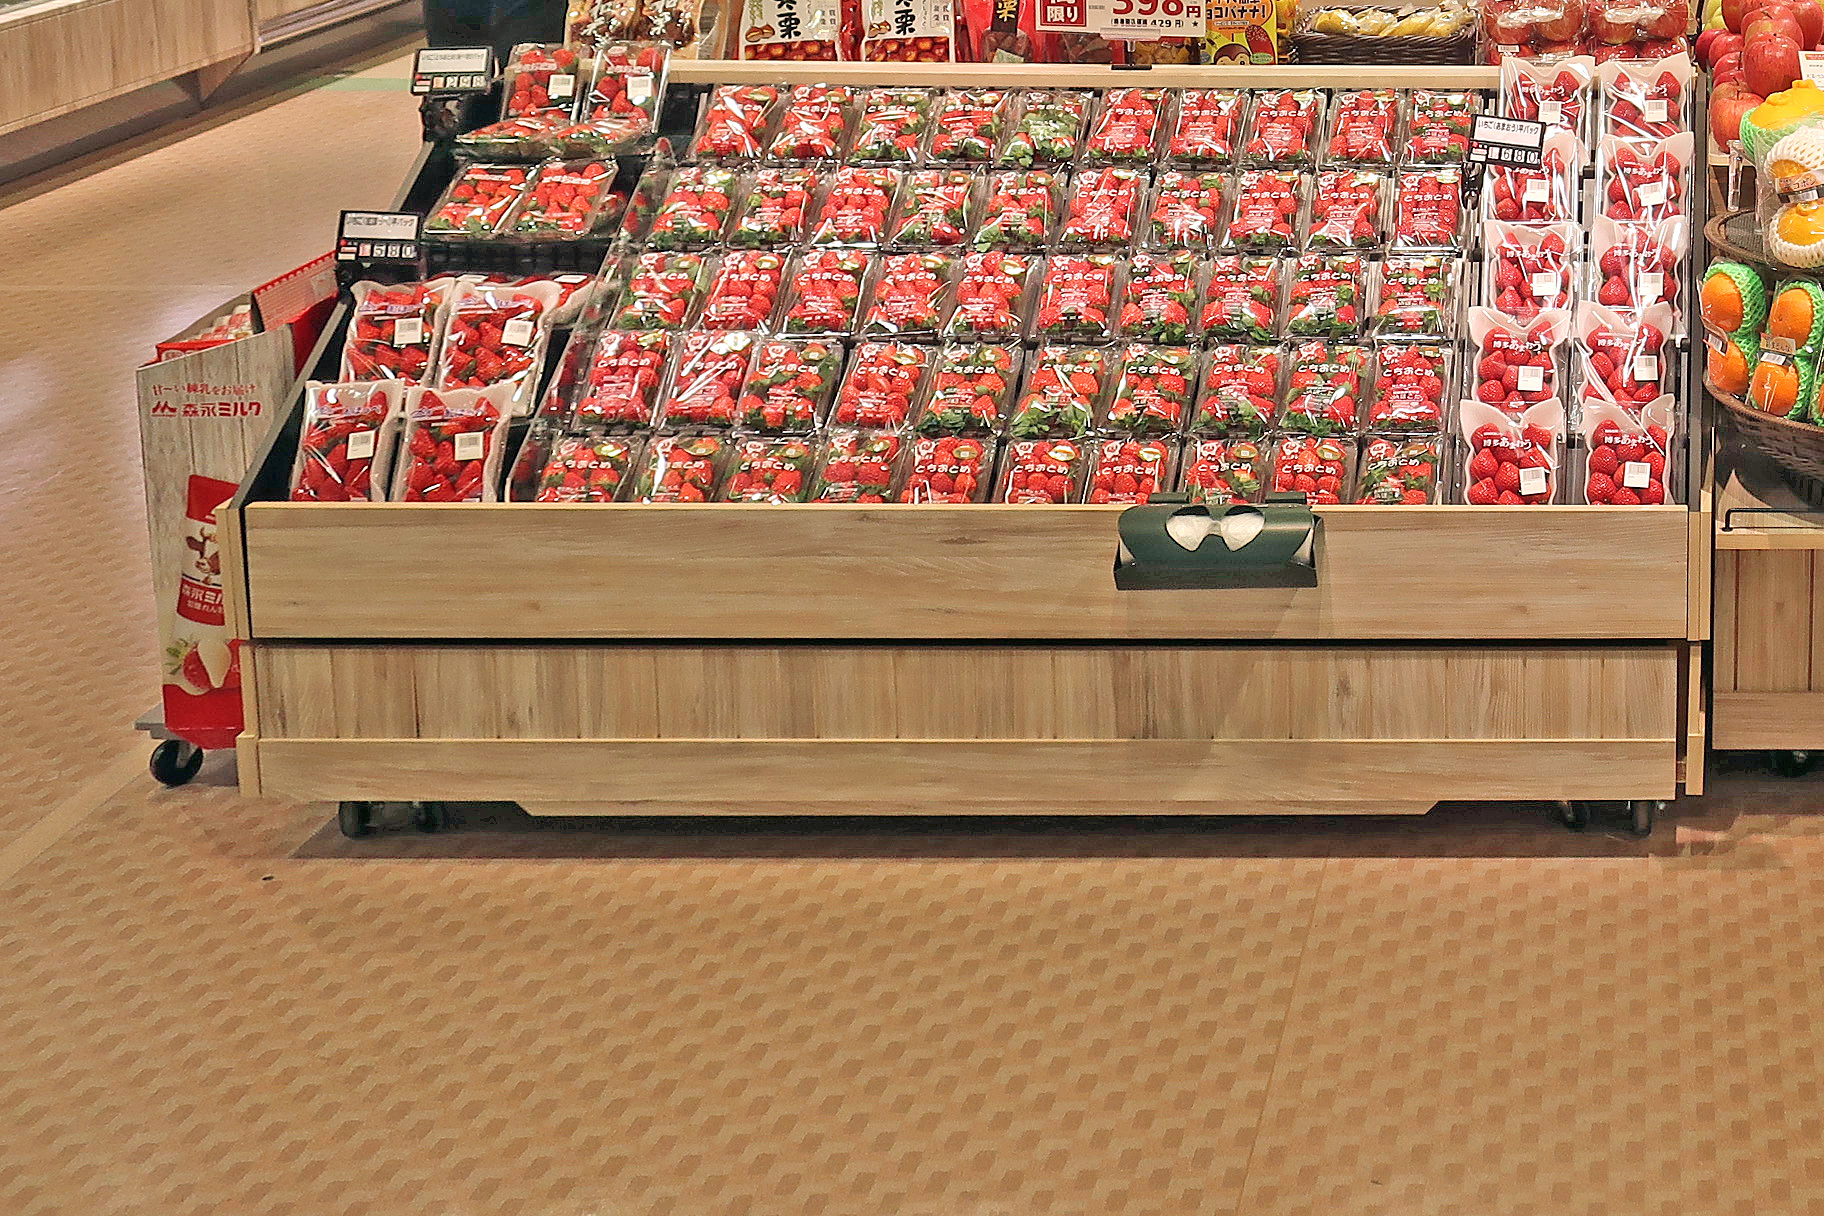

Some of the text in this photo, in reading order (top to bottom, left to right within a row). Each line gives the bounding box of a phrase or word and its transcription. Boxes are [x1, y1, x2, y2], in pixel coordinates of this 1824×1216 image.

[1259, 109, 1308, 118] とちおとめ
[833, 187, 883, 196] とちおとめ
[1078, 190, 1128, 199] とちおとめ
[1161, 190, 1209, 199] とちおとめ
[1241, 191, 1290, 200] とちおとめ
[1320, 191, 1369, 200] とちおとめ
[1404, 193, 1452, 202] とちおとめ
[798, 273, 850, 283] とちおとめ
[963, 275, 1015, 284] とちおとめ
[1053, 272, 1104, 282] とちおとめ
[1388, 277, 1438, 286] とちおとめ
[598, 358, 650, 367] とちおとめ
[857, 366, 909, 376] とちおとめ
[1127, 365, 1180, 375] とちおとめ
[1213, 364, 1265, 374] とちおとめ
[1297, 363, 1350, 374] とちおとめ
[1382, 367, 1436, 376] とちおとめ
[182, 402, 261, 417] 森永ミルク
[740, 460, 796, 471] とちおとめ
[915, 464, 970, 474] とちおとめ
[1014, 464, 1070, 475] とちおとめ
[1102, 464, 1156, 476] とちおとめ
[1282, 464, 1336, 475] とちおとめ
